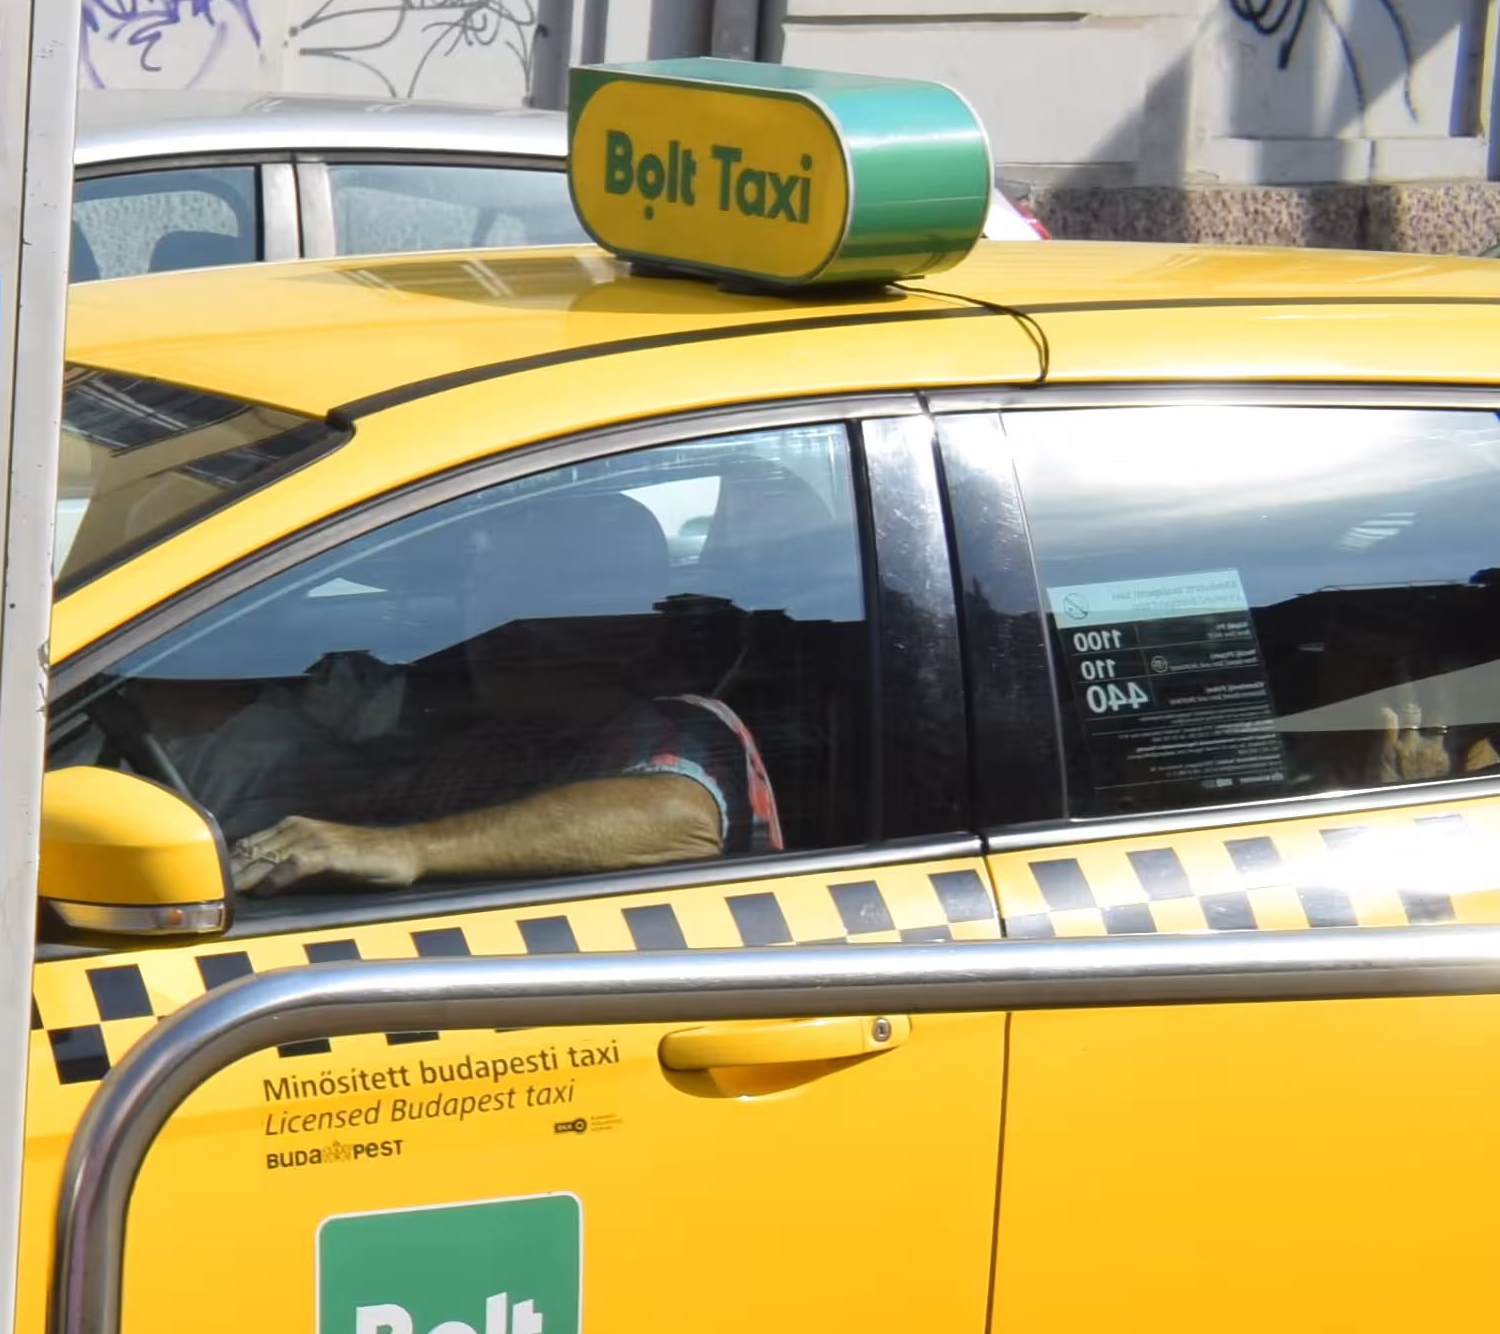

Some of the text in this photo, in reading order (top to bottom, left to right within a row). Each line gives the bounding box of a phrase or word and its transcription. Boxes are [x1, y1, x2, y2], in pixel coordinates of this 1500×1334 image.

[606, 129, 813, 223] Bolt Taxi
[263, 1039, 620, 1102] Minősített budapesti taxi
[265, 1078, 577, 1136] Licensed Budapest taxi
